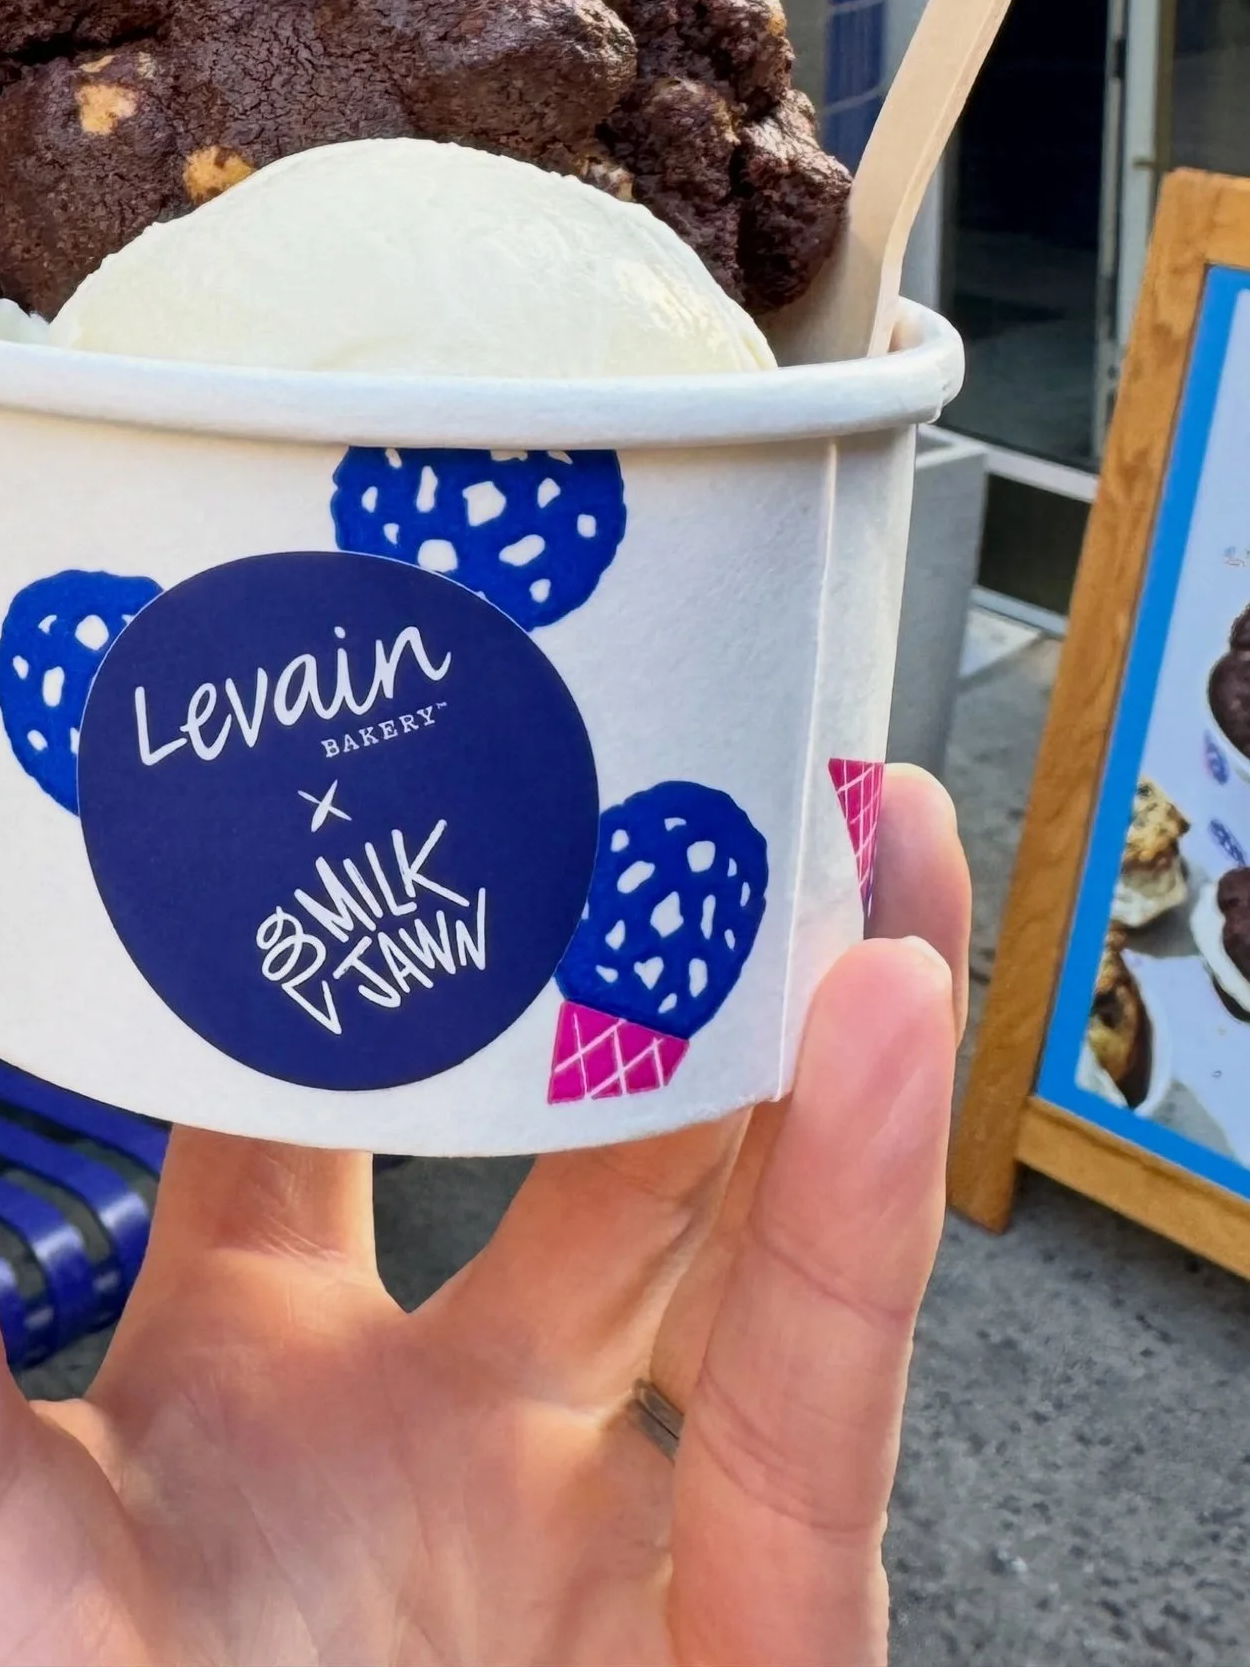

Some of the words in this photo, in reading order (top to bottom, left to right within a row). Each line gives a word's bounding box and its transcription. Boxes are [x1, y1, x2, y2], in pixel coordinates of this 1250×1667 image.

[134, 626, 451, 766] Levain
[293, 819, 470, 943] MILK
[333, 887, 487, 1008] JAWN
